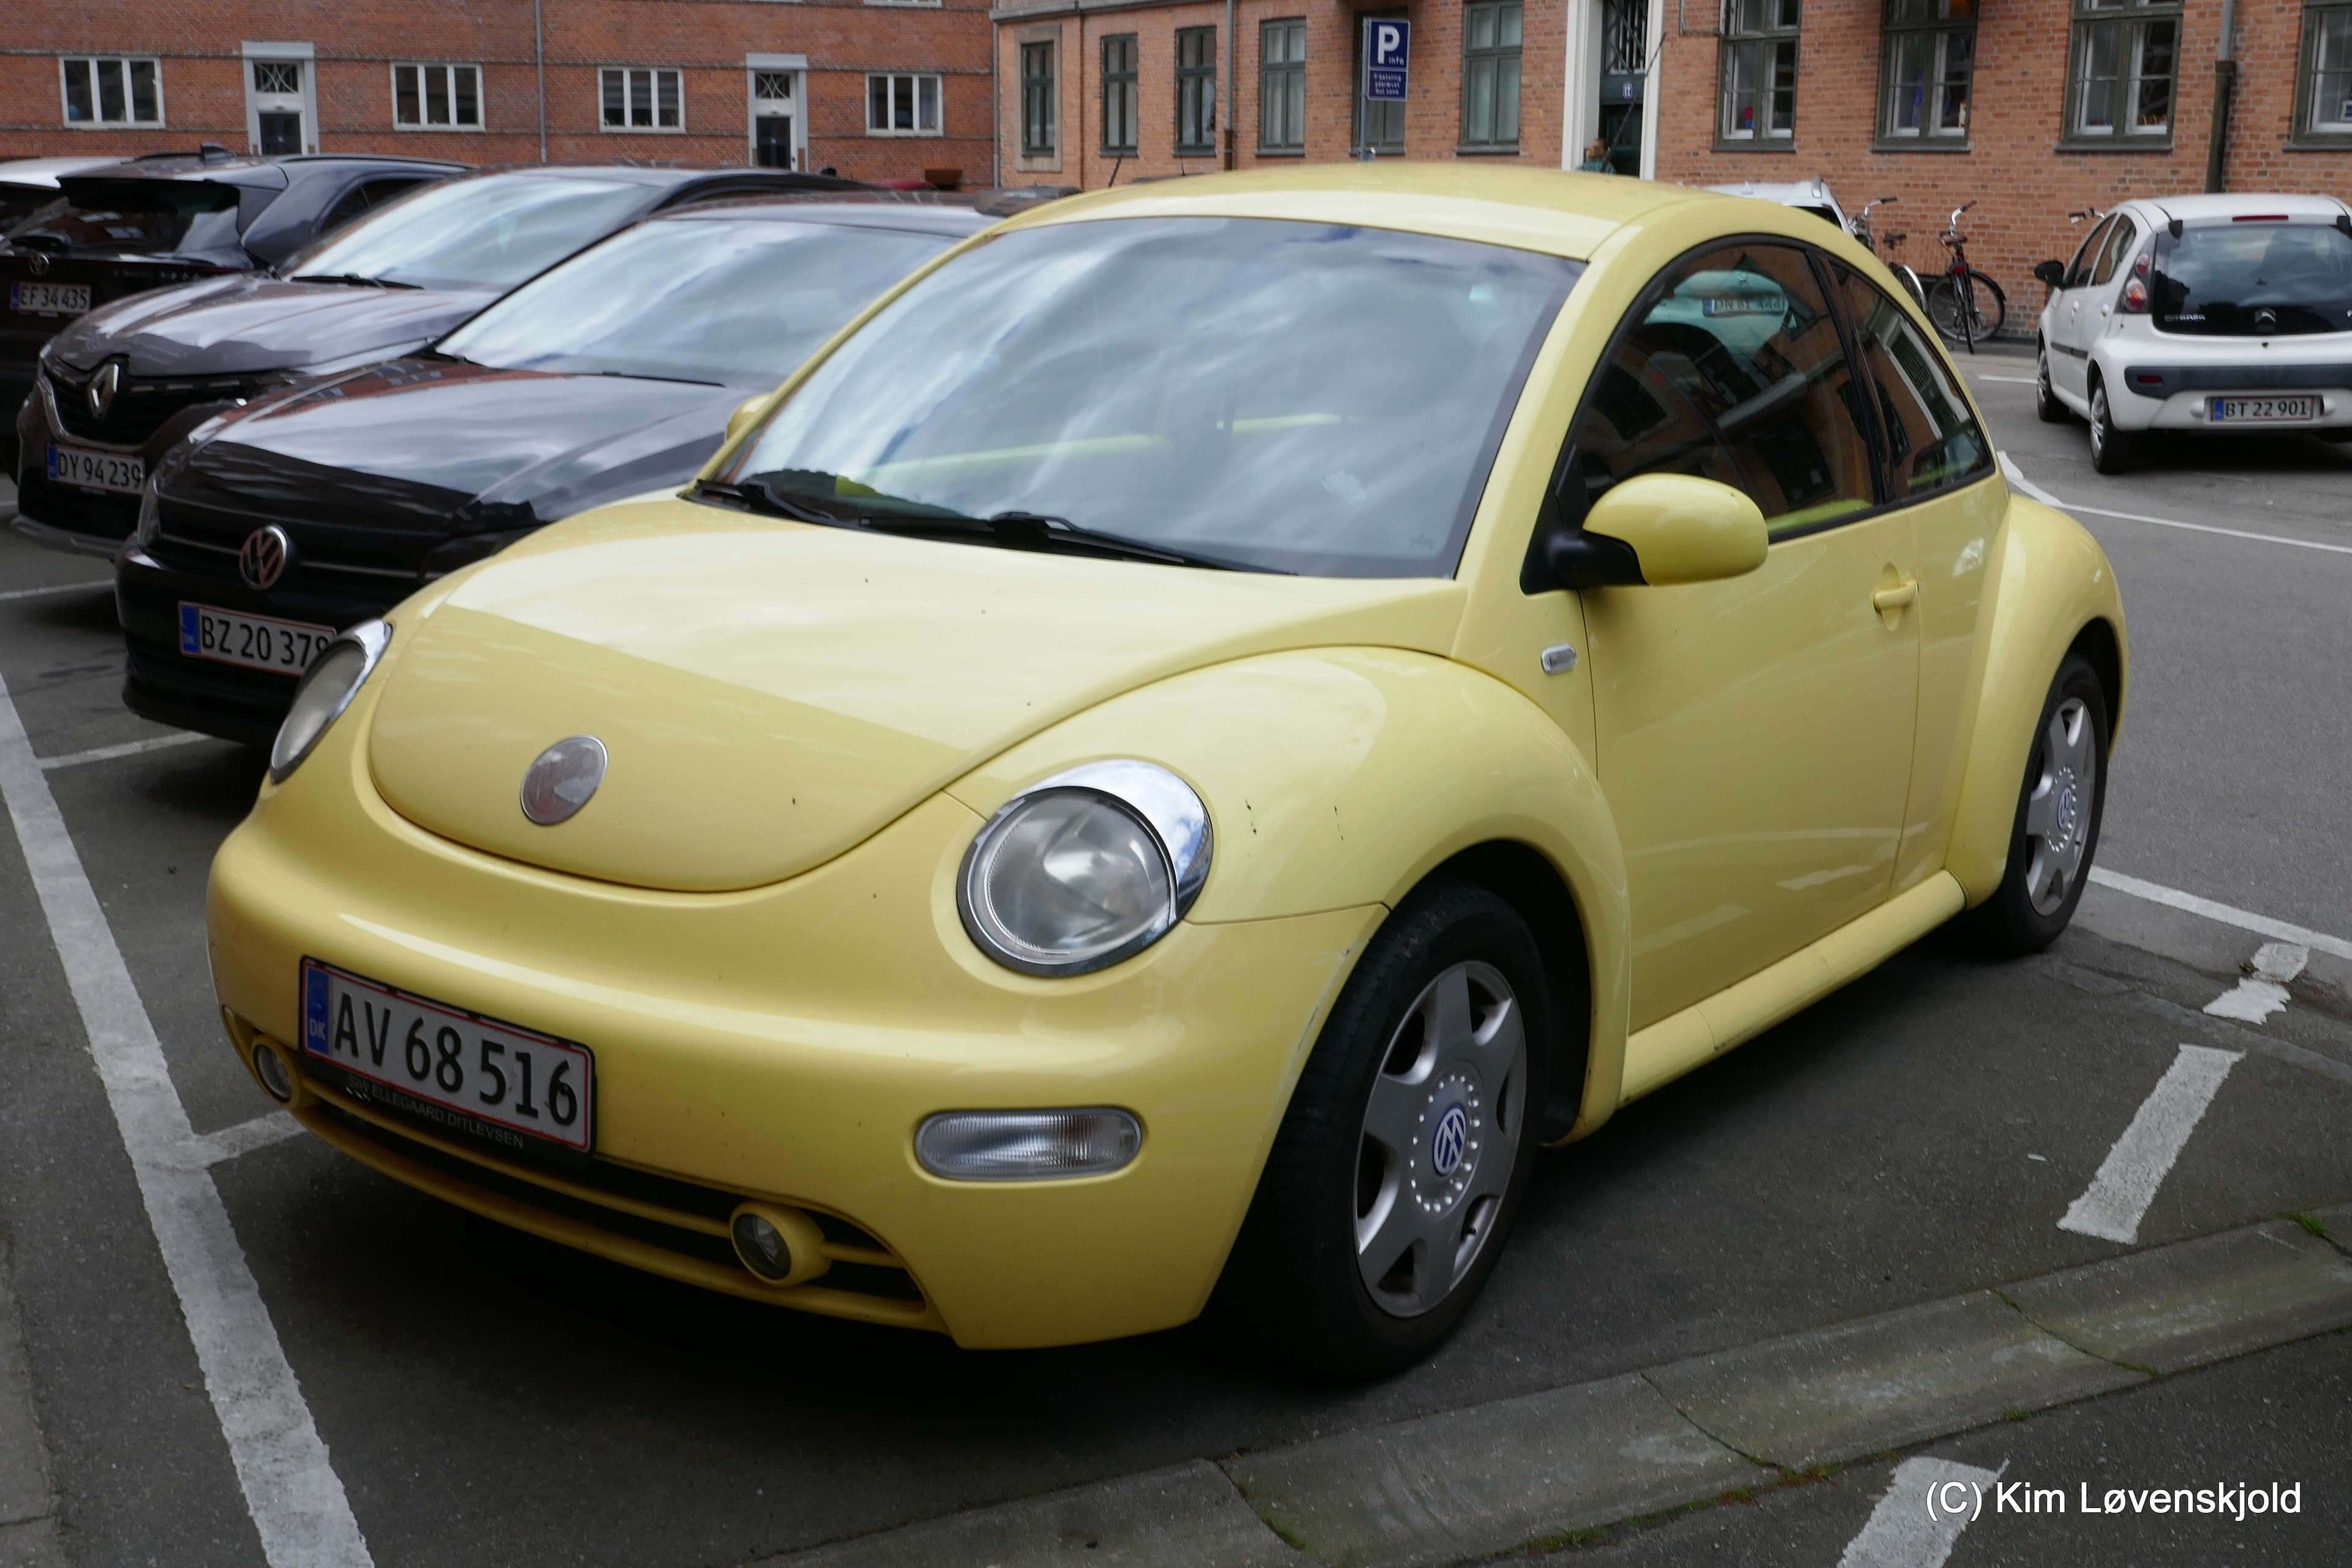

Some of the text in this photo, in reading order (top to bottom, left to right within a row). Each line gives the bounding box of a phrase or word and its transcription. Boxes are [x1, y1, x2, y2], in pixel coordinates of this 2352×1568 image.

[1378, 24, 1400, 64] P
[2225, 399, 2307, 417] BT 22 901
[58, 453, 141, 489] DY 94 239
[202, 615, 232, 655] BZ
[239, 624, 272, 662] 20
[309, 1017, 327, 1041] DK
[334, 992, 578, 1126] AV 68 516
[372, 1085, 445, 1123] ELLEGAARD
[447, 1114, 524, 1148] DITLEVSEN
